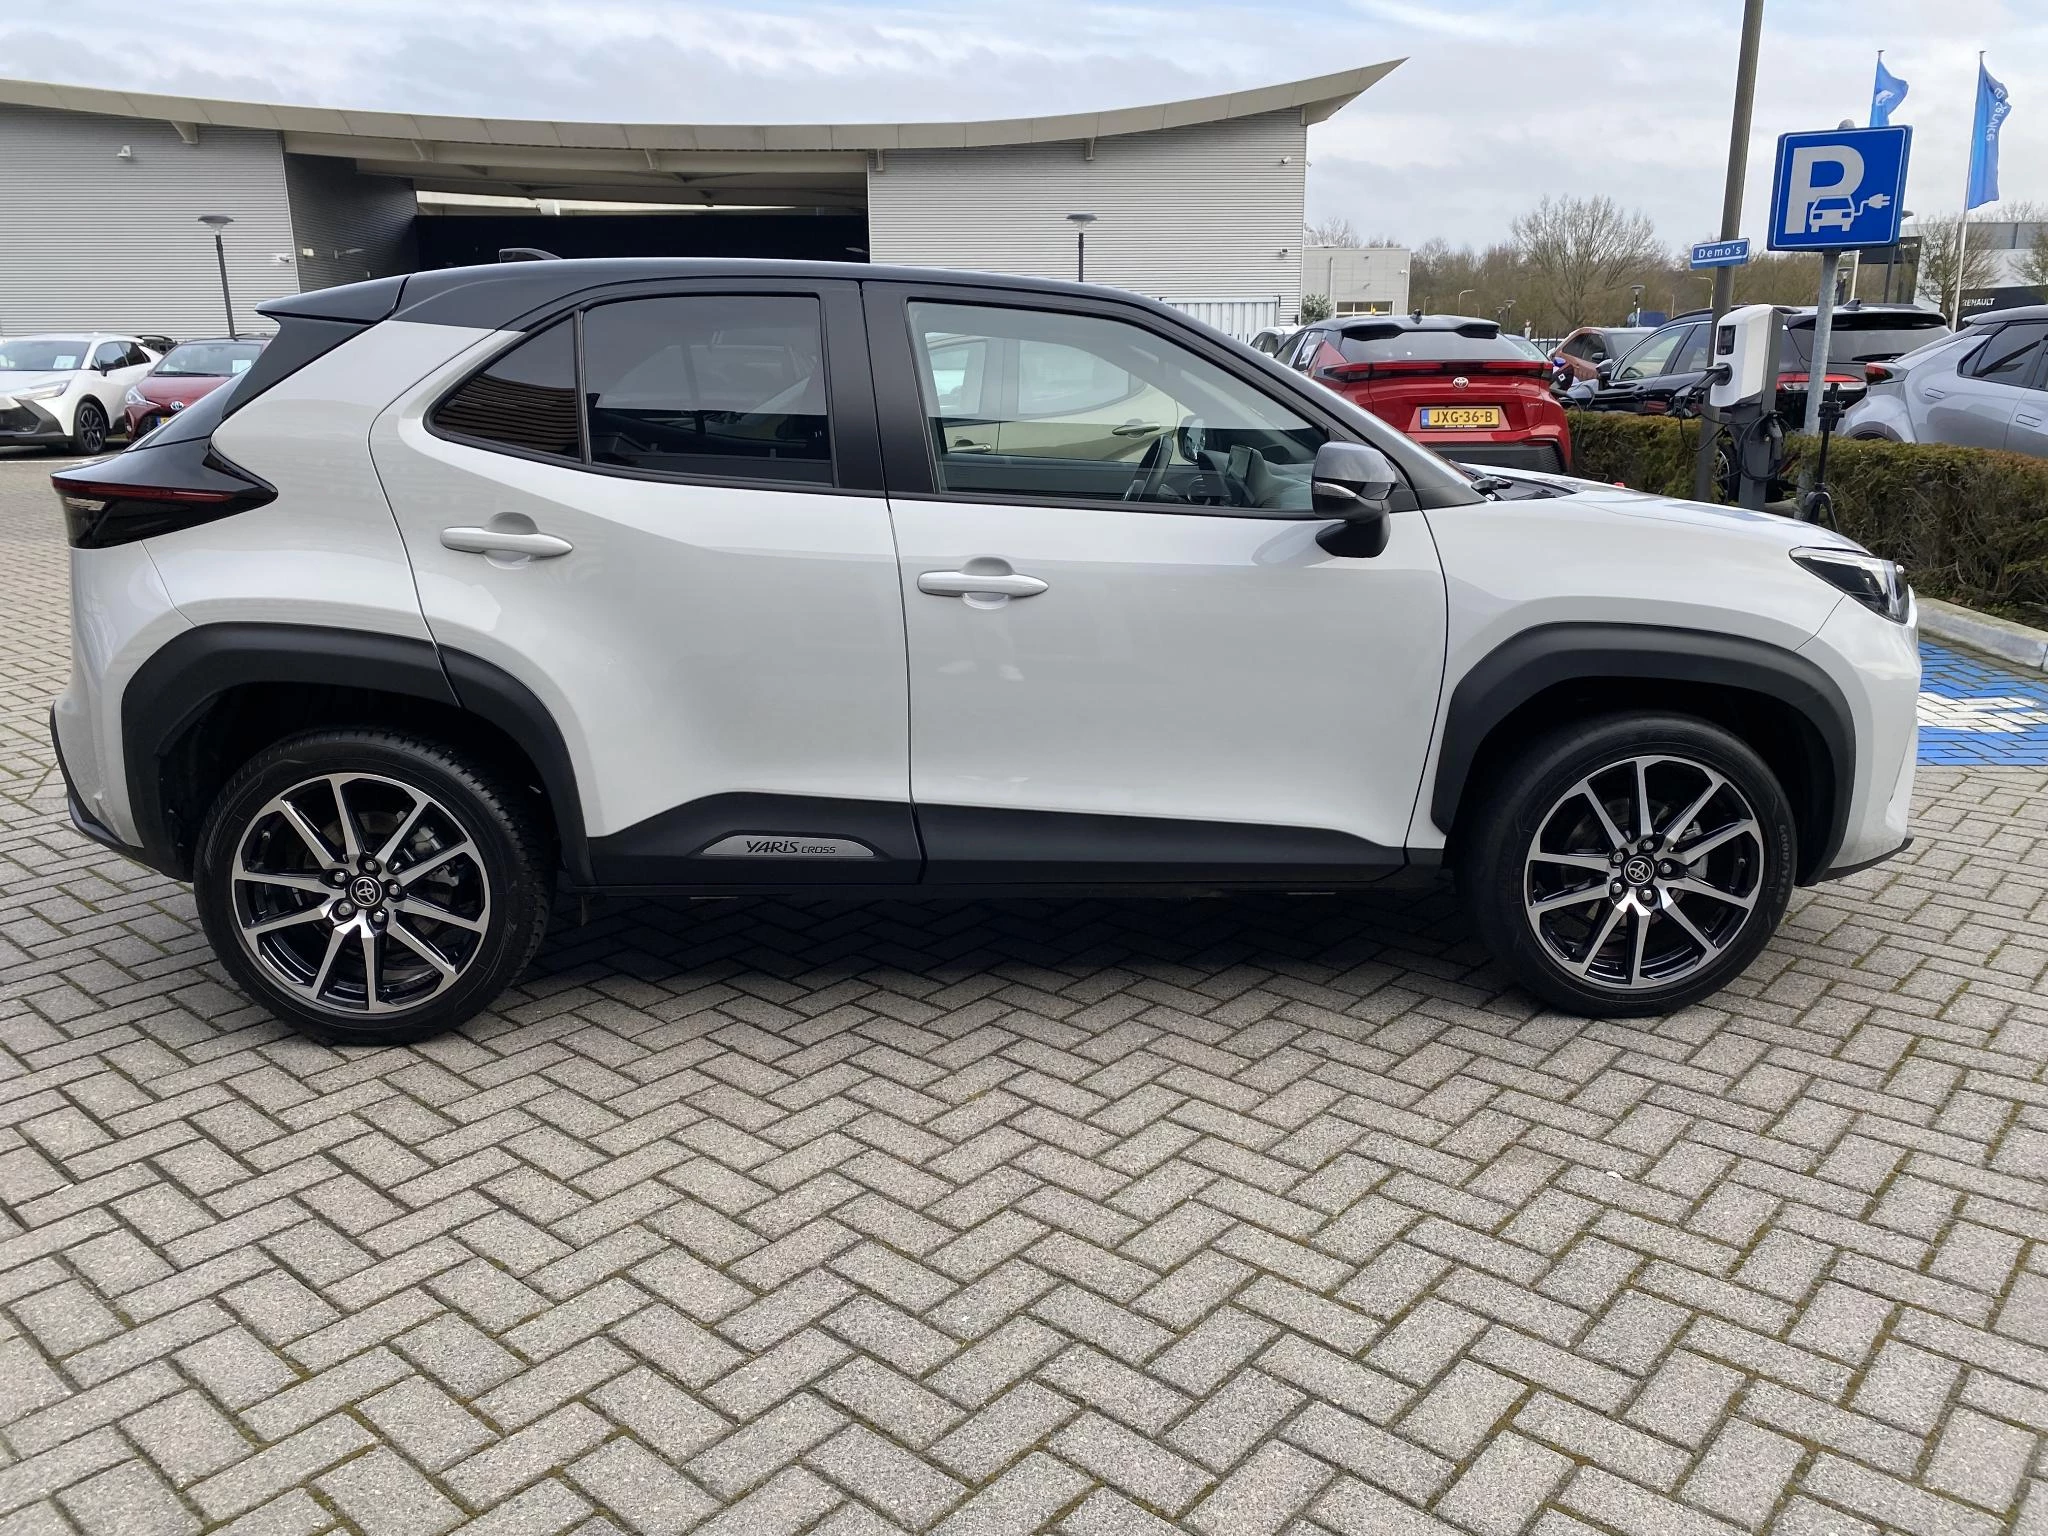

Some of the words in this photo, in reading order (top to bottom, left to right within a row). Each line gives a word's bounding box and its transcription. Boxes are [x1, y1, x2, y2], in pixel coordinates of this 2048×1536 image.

[1784, 145, 1865, 234] P
[1698, 245, 1741, 258] Demo's
[1433, 411, 1493, 423] JXG-36-B
[801, 846, 836, 854] CROSS
